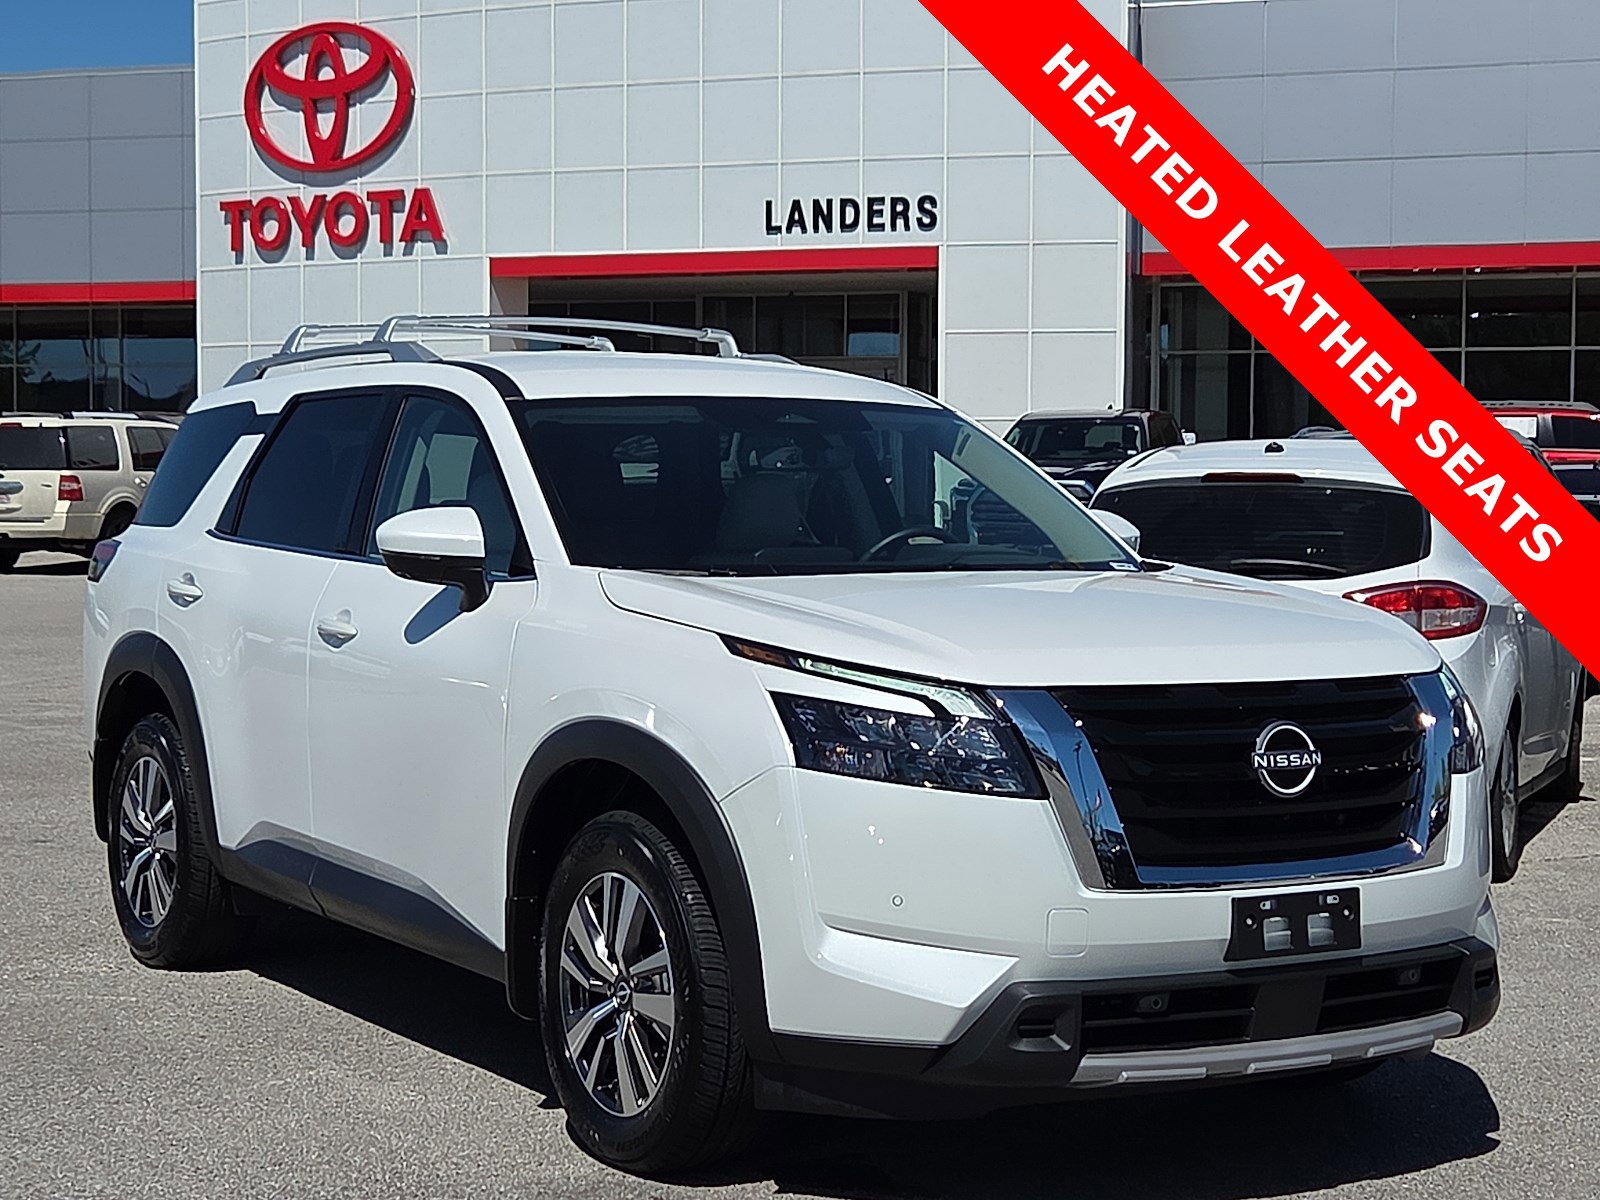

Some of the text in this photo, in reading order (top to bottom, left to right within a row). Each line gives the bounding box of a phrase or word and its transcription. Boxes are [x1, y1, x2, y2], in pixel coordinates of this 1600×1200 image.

[220, 188, 445, 251] TOYOTA
[765, 195, 938, 236] LANDERS
[1253, 752, 1322, 768] NISSAN
